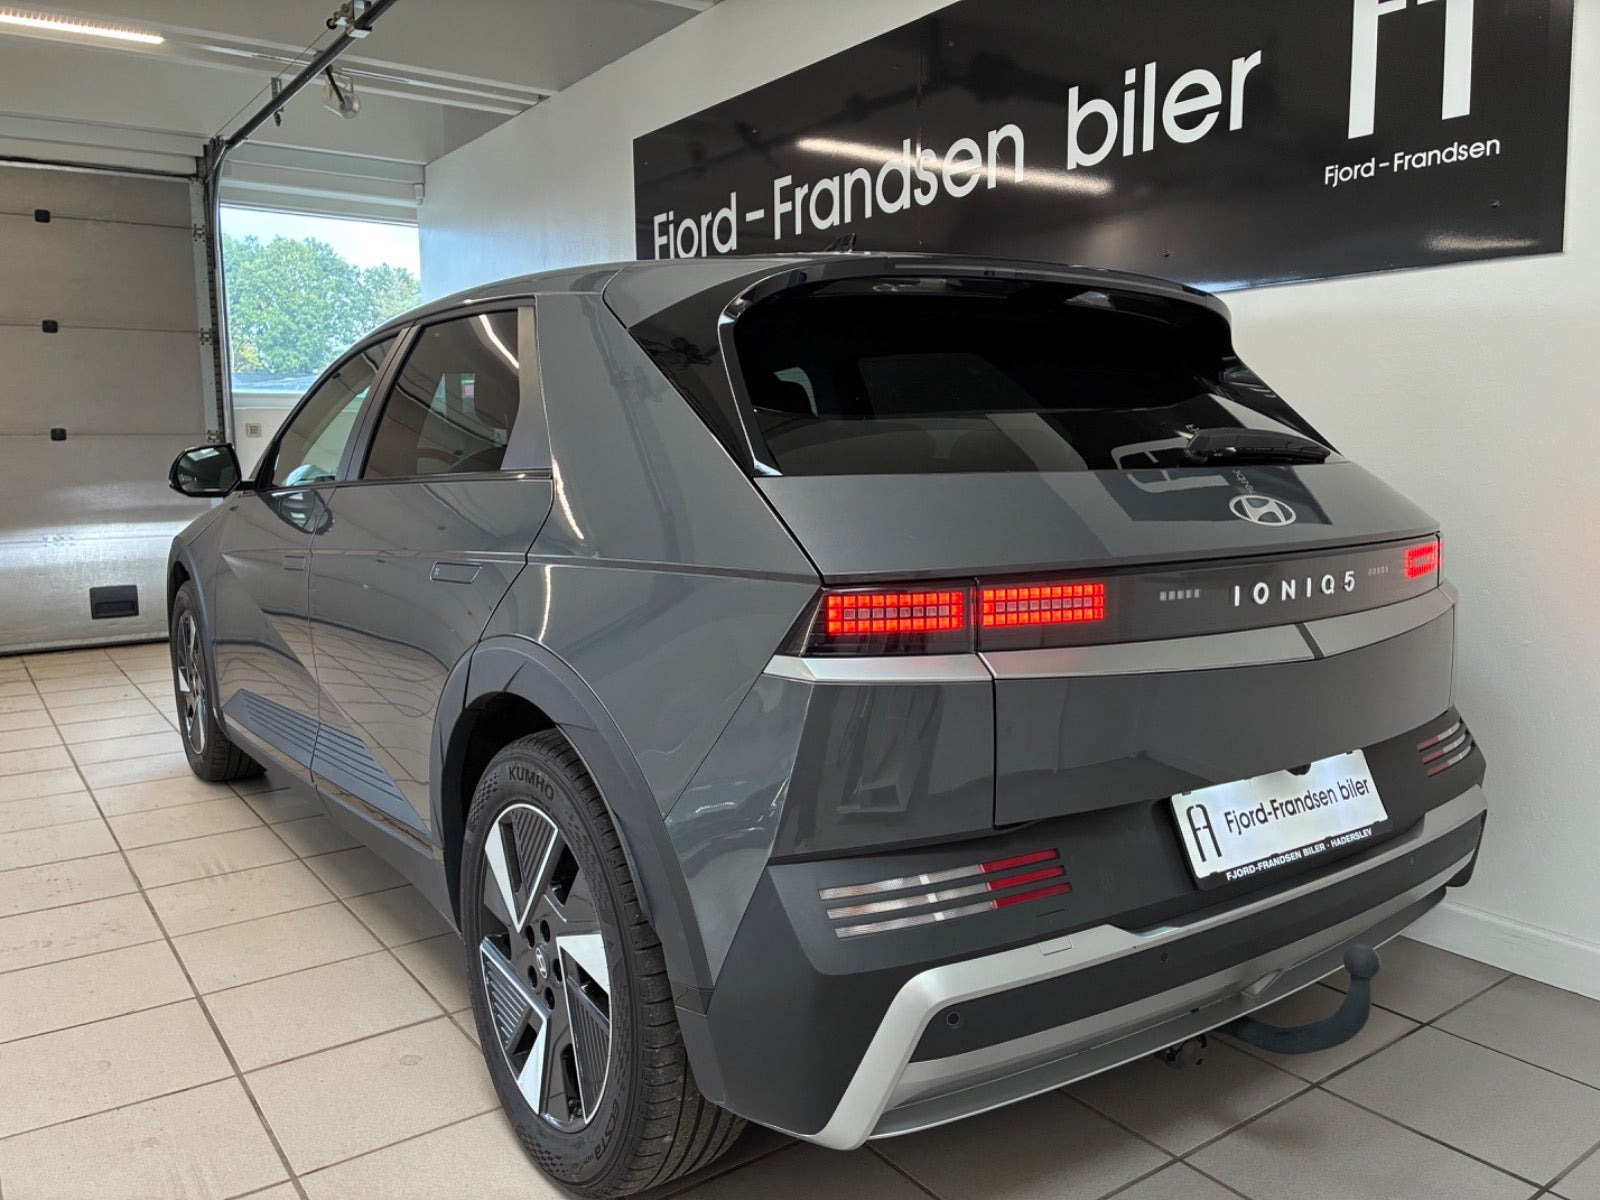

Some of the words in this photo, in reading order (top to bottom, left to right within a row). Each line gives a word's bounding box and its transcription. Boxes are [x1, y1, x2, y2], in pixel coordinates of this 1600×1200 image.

[1067, 50, 1262, 170] biler
[509, 765, 554, 801] KUMHO
[1224, 790, 1339, 836] Fjord-Frandsen
[1337, 778, 1371, 801] biler
[1226, 850, 1303, 881] FJORD-FRANDSEN
[1302, 842, 1326, 857] BILER
[1330, 827, 1373, 848] HADERSLEV
